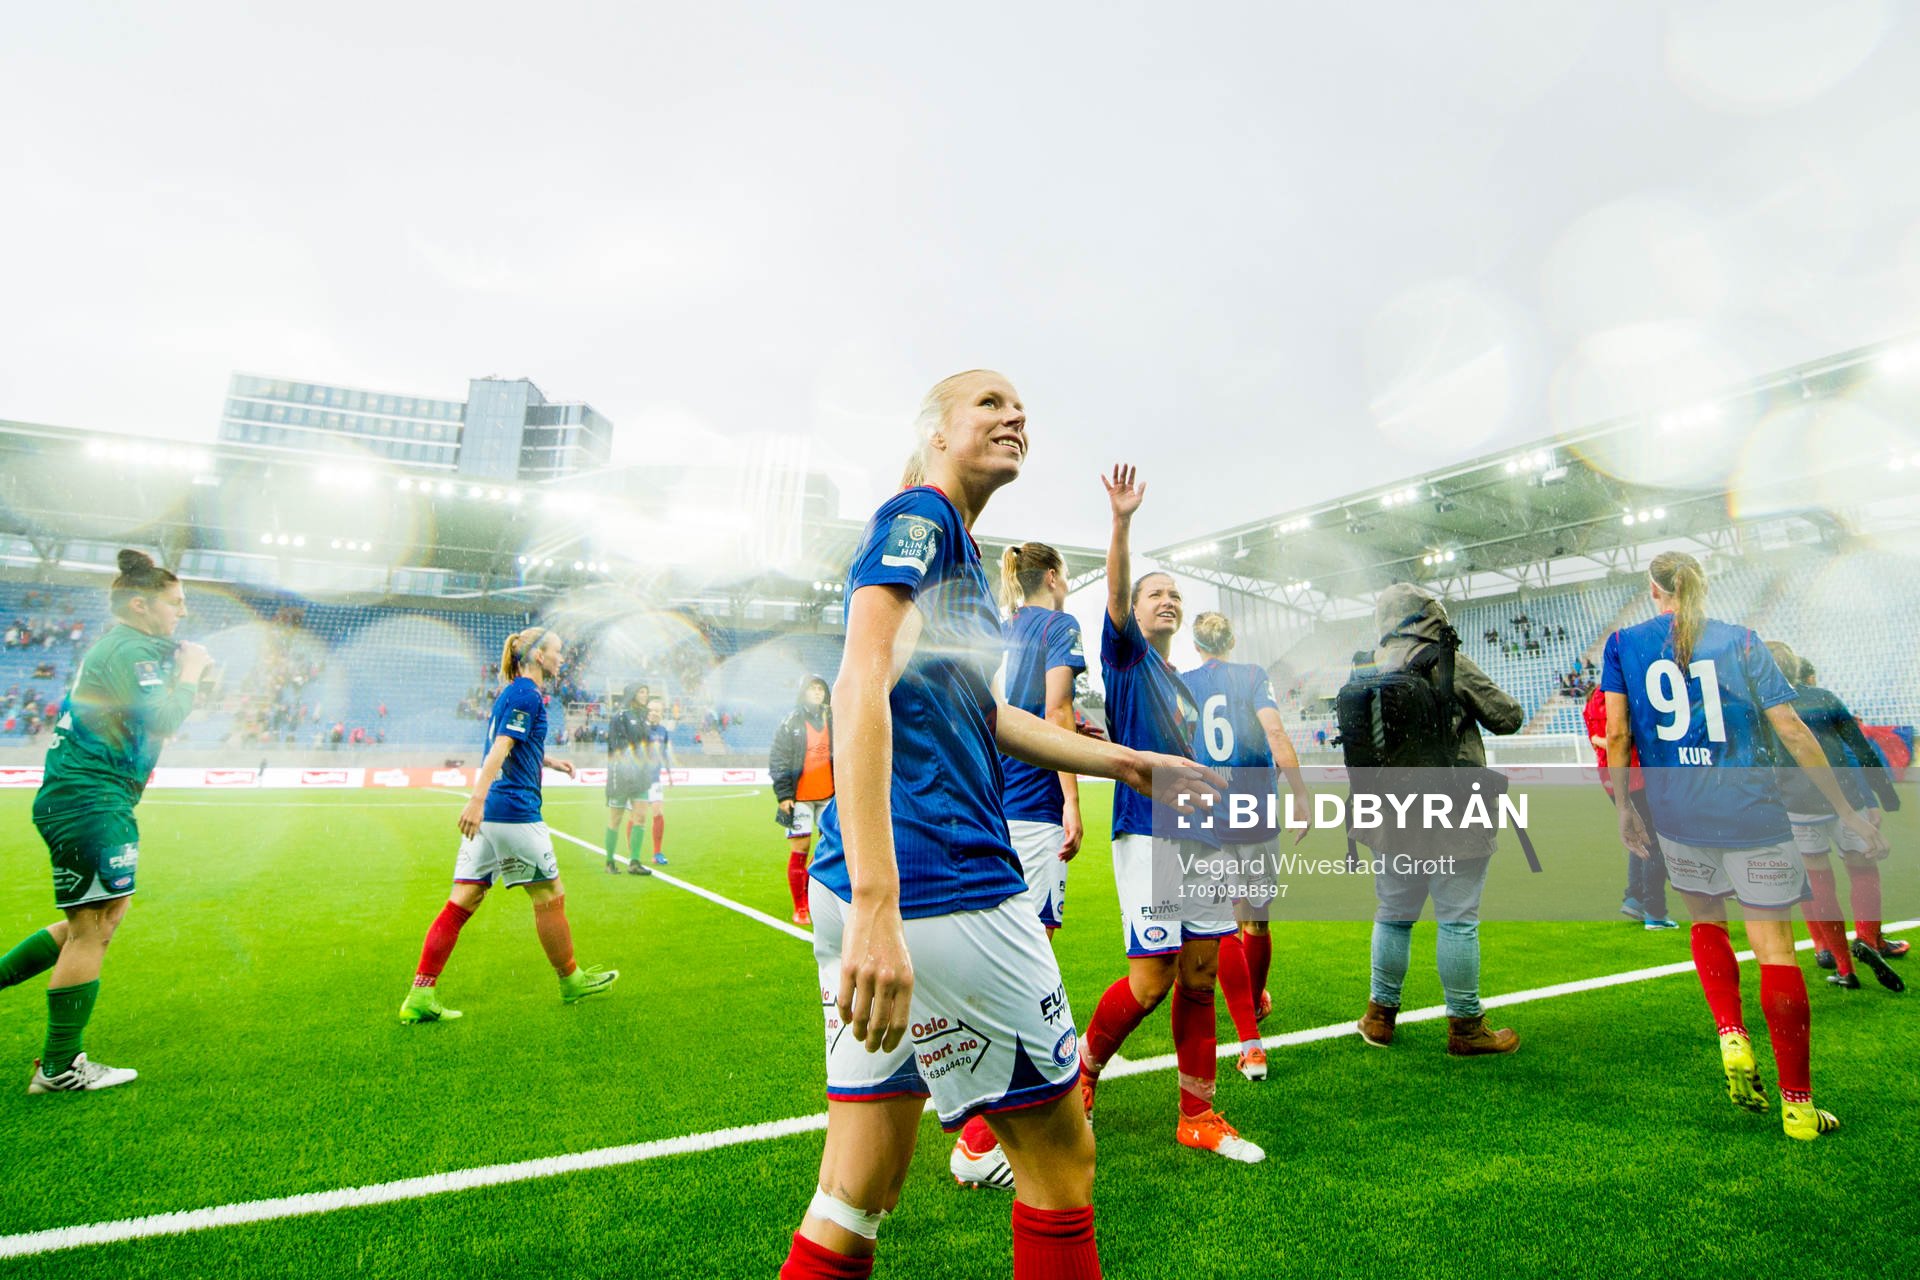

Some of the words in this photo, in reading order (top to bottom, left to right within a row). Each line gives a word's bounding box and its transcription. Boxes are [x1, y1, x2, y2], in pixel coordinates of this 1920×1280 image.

[900, 548, 922, 557] HUS
[1645, 659, 1727, 743] 91
[1203, 693, 1235, 762] 6
[1678, 746, 1713, 766] KUR
[1769, 860, 1788, 868] Oslo
[911, 1017, 948, 1038] Oslo
